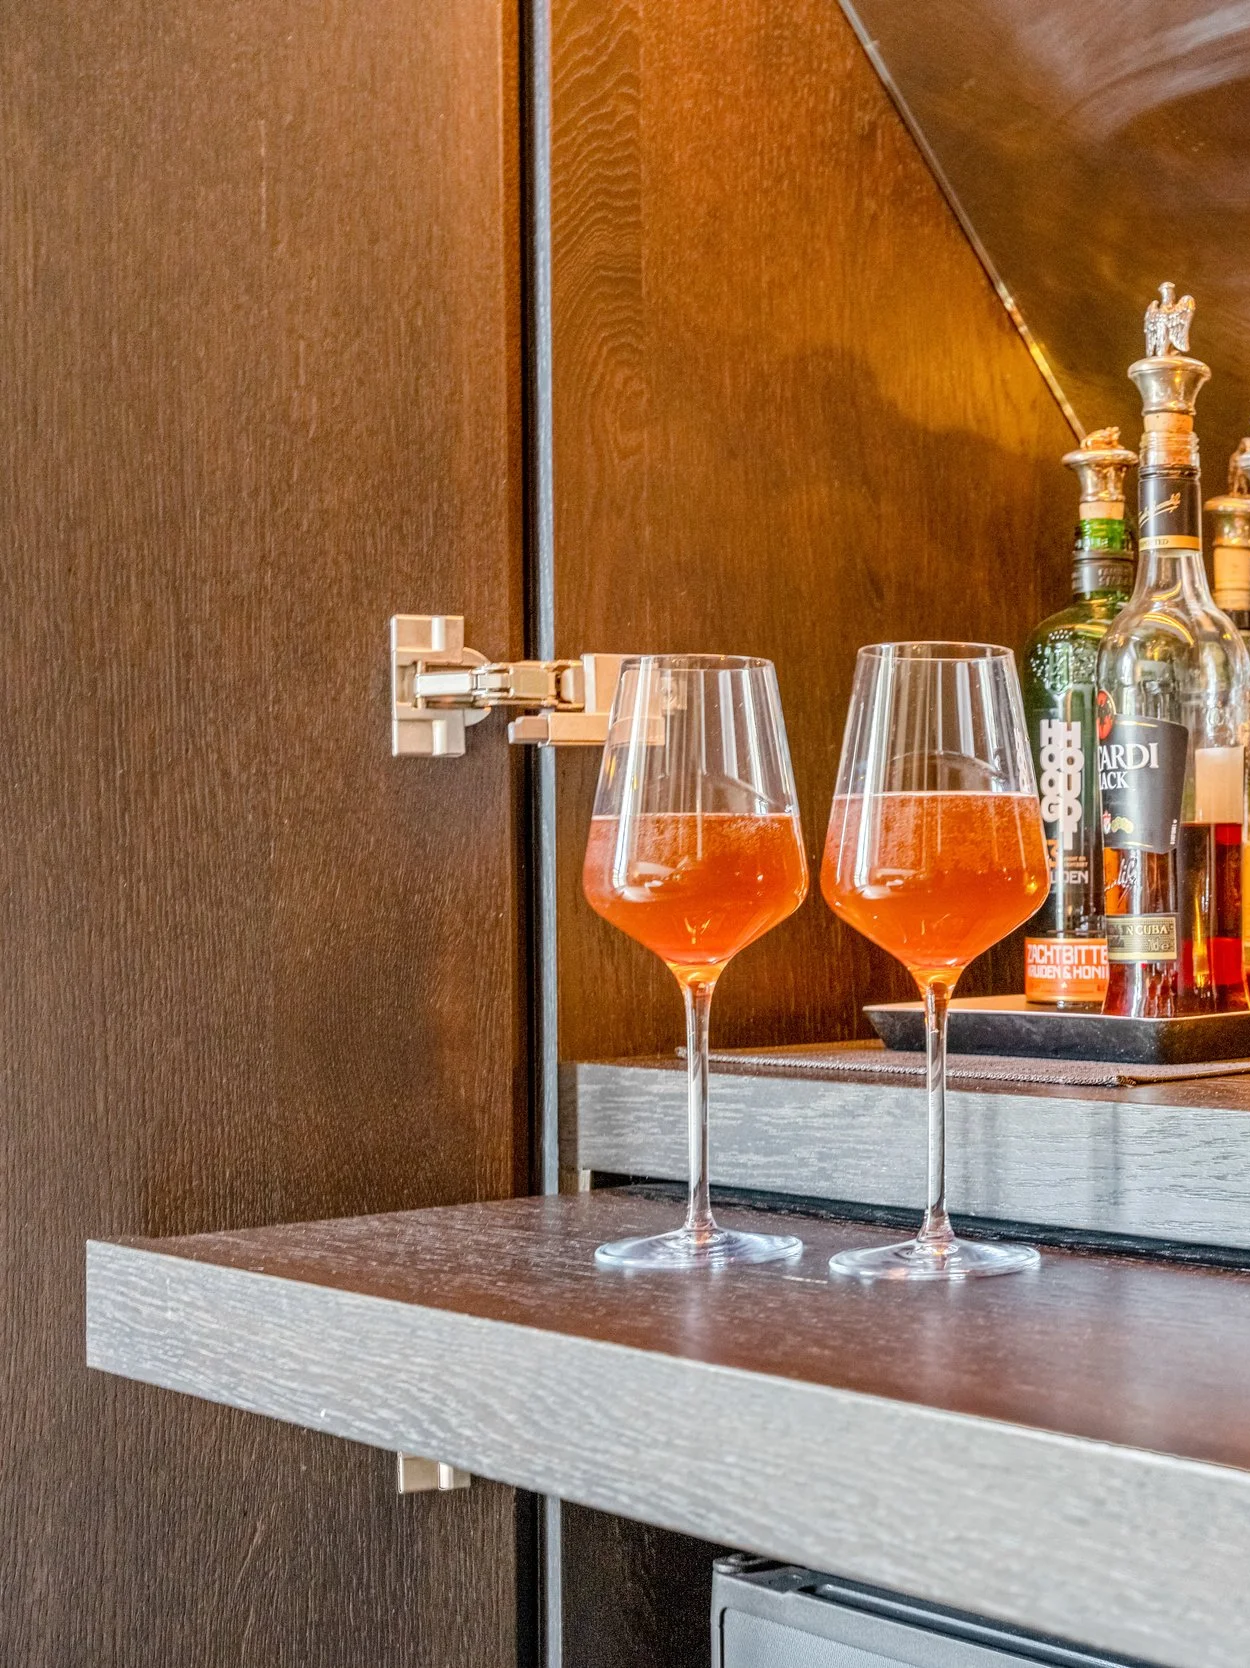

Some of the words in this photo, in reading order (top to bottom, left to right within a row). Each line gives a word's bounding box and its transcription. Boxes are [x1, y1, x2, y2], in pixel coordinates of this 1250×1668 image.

[1040, 718, 1062, 823] HOOG
[1099, 771, 1130, 790] ACK
[1135, 924, 1168, 936] CUBA
[1027, 944, 1108, 965] ZACHTBITTE
[1063, 965, 1073, 979] &
[1073, 965, 1109, 980] HONI
